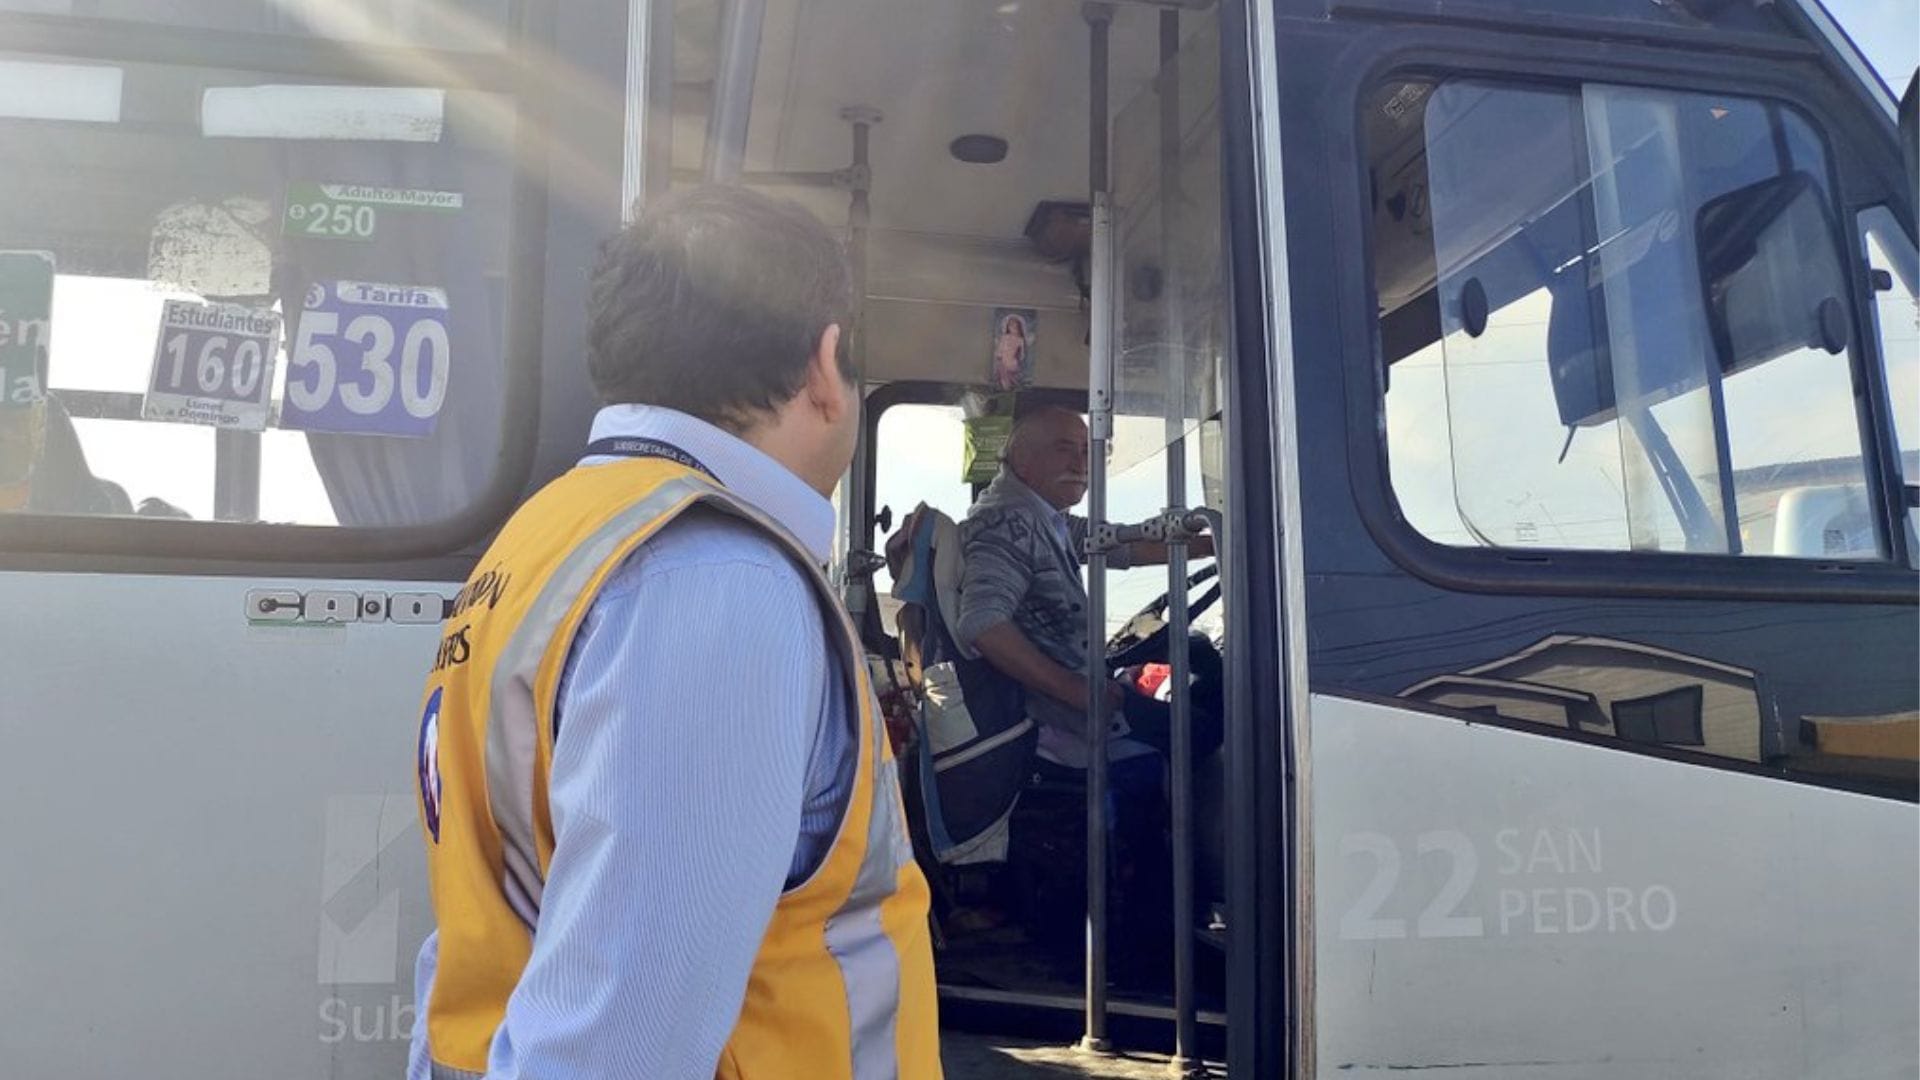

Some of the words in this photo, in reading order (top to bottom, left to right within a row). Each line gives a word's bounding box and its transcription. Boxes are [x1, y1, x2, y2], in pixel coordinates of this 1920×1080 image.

[337, 185, 394, 201] Adulto
[402, 189, 458, 206] Mayor
[306, 203, 375, 236] 250
[357, 285, 429, 305] Tarifa
[168, 304, 273, 334] Estudiantes
[167, 333, 262, 397] 160
[287, 311, 450, 419] 530
[177, 408, 240, 424] Domingo
[1495, 829, 1601, 875] SAN
[1338, 828, 1485, 940] 22
[1500, 885, 1678, 934] PEDRO
